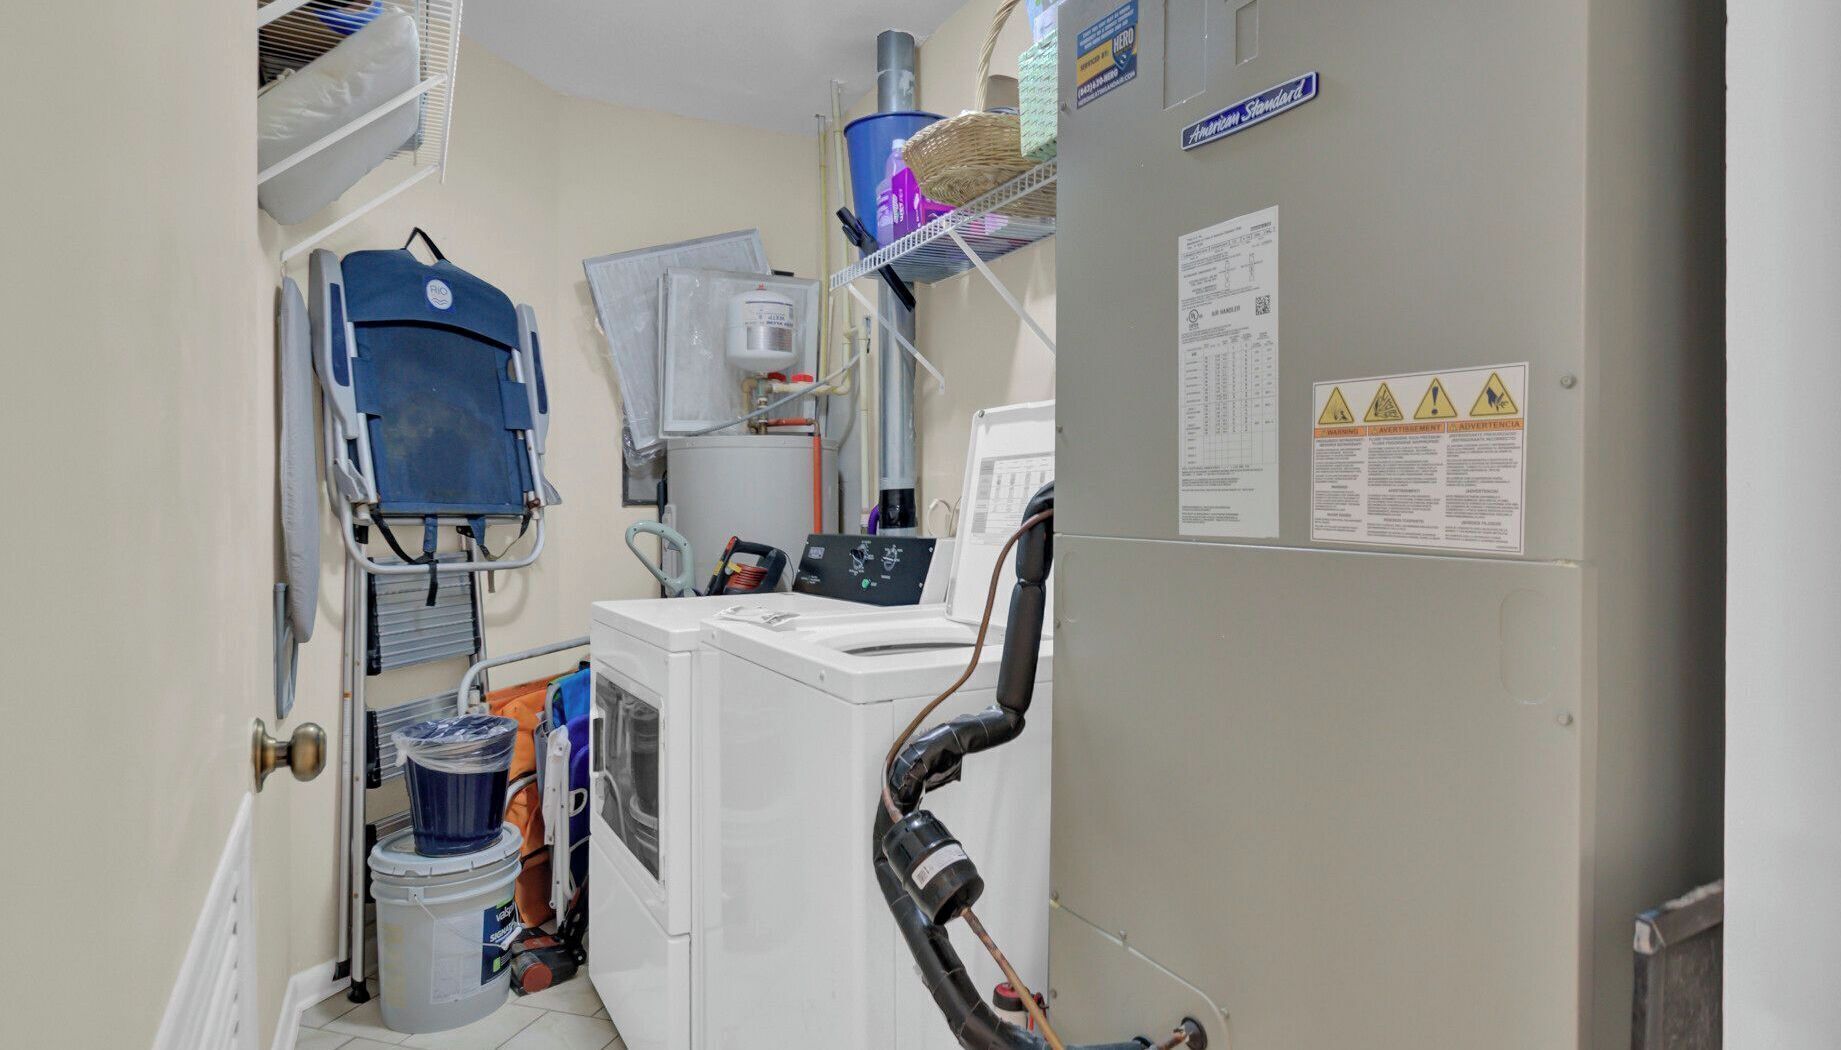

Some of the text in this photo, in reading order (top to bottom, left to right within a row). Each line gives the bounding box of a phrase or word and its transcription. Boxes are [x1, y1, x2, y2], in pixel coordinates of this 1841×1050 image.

[1113, 27, 1134, 54] HERO
[1189, 78, 1306, 145] American Standard
[1327, 428, 1359, 436] WARNING
[1459, 420, 1521, 430] ADVERTENCIA
[496, 904, 514, 921] valsp
